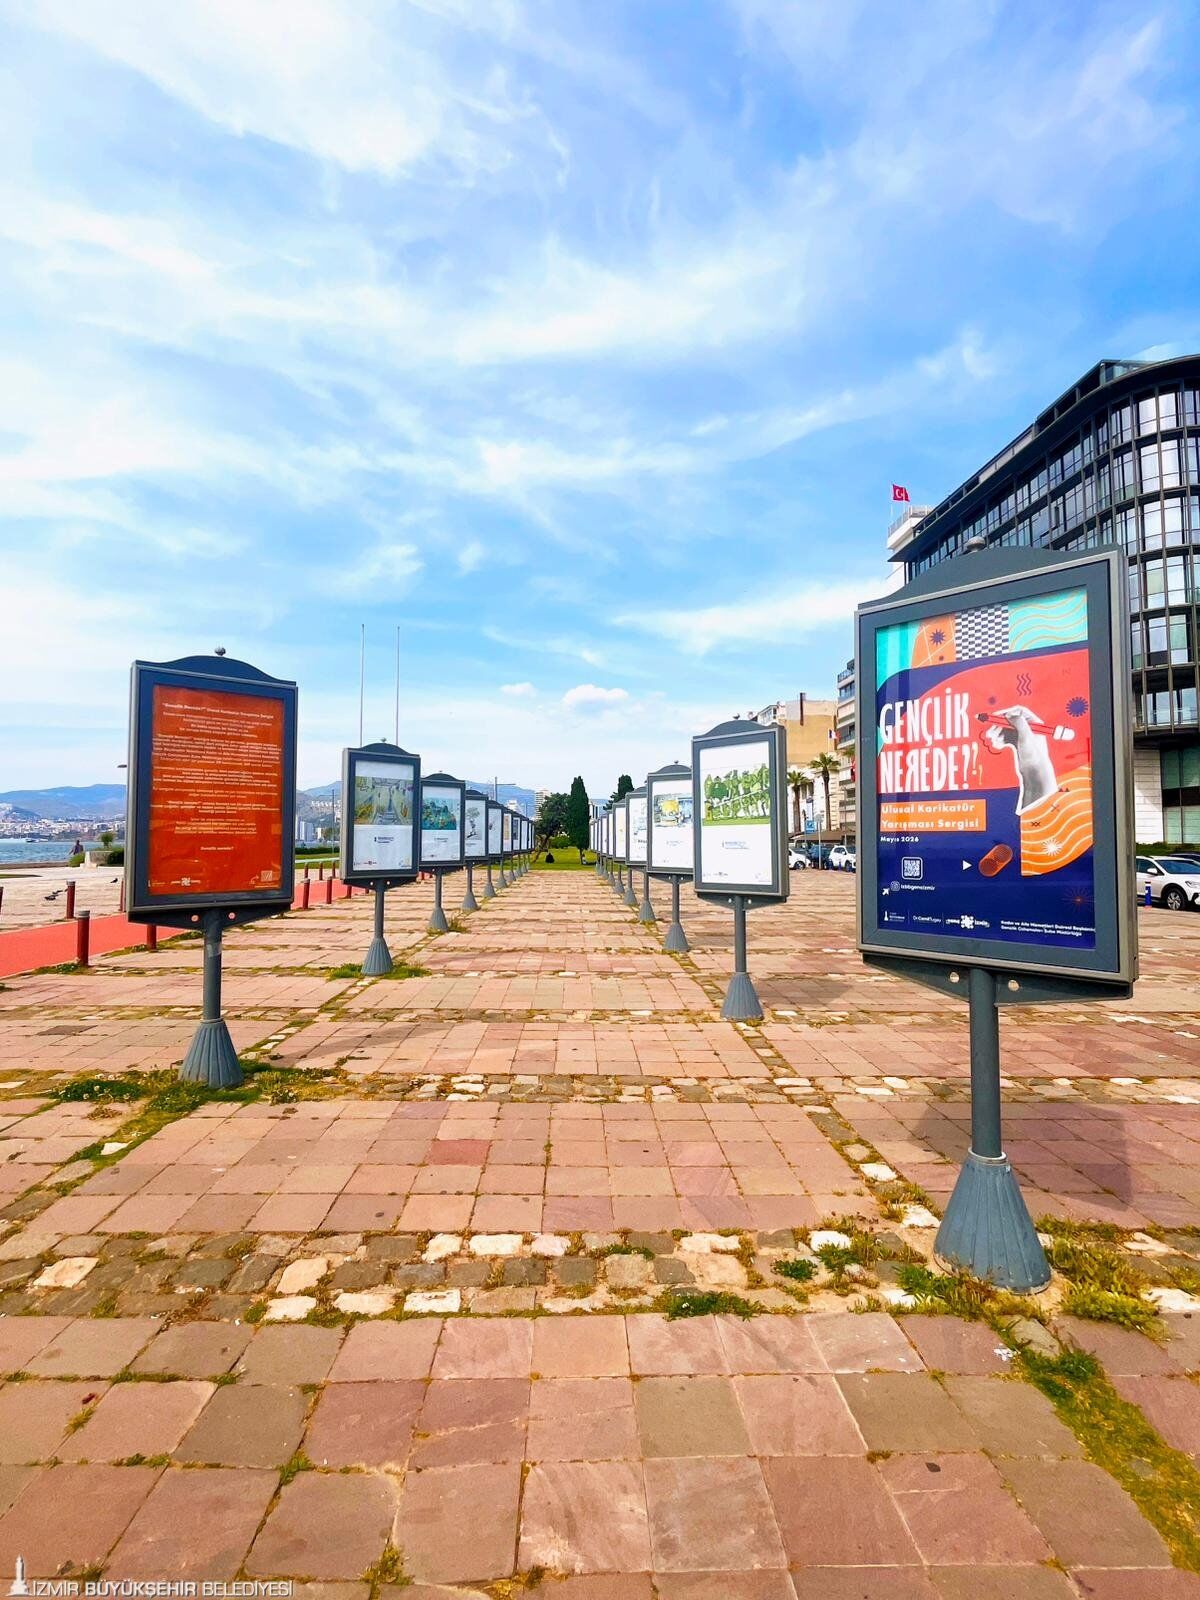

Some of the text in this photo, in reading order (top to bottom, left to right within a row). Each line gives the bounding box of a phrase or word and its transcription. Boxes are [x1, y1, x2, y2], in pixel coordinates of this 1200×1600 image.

[880, 687, 970, 746] GENÇLİK
[881, 802, 975, 814] Ulusal Karikatür
[881, 818, 979, 831] Yarışması Sergisi
